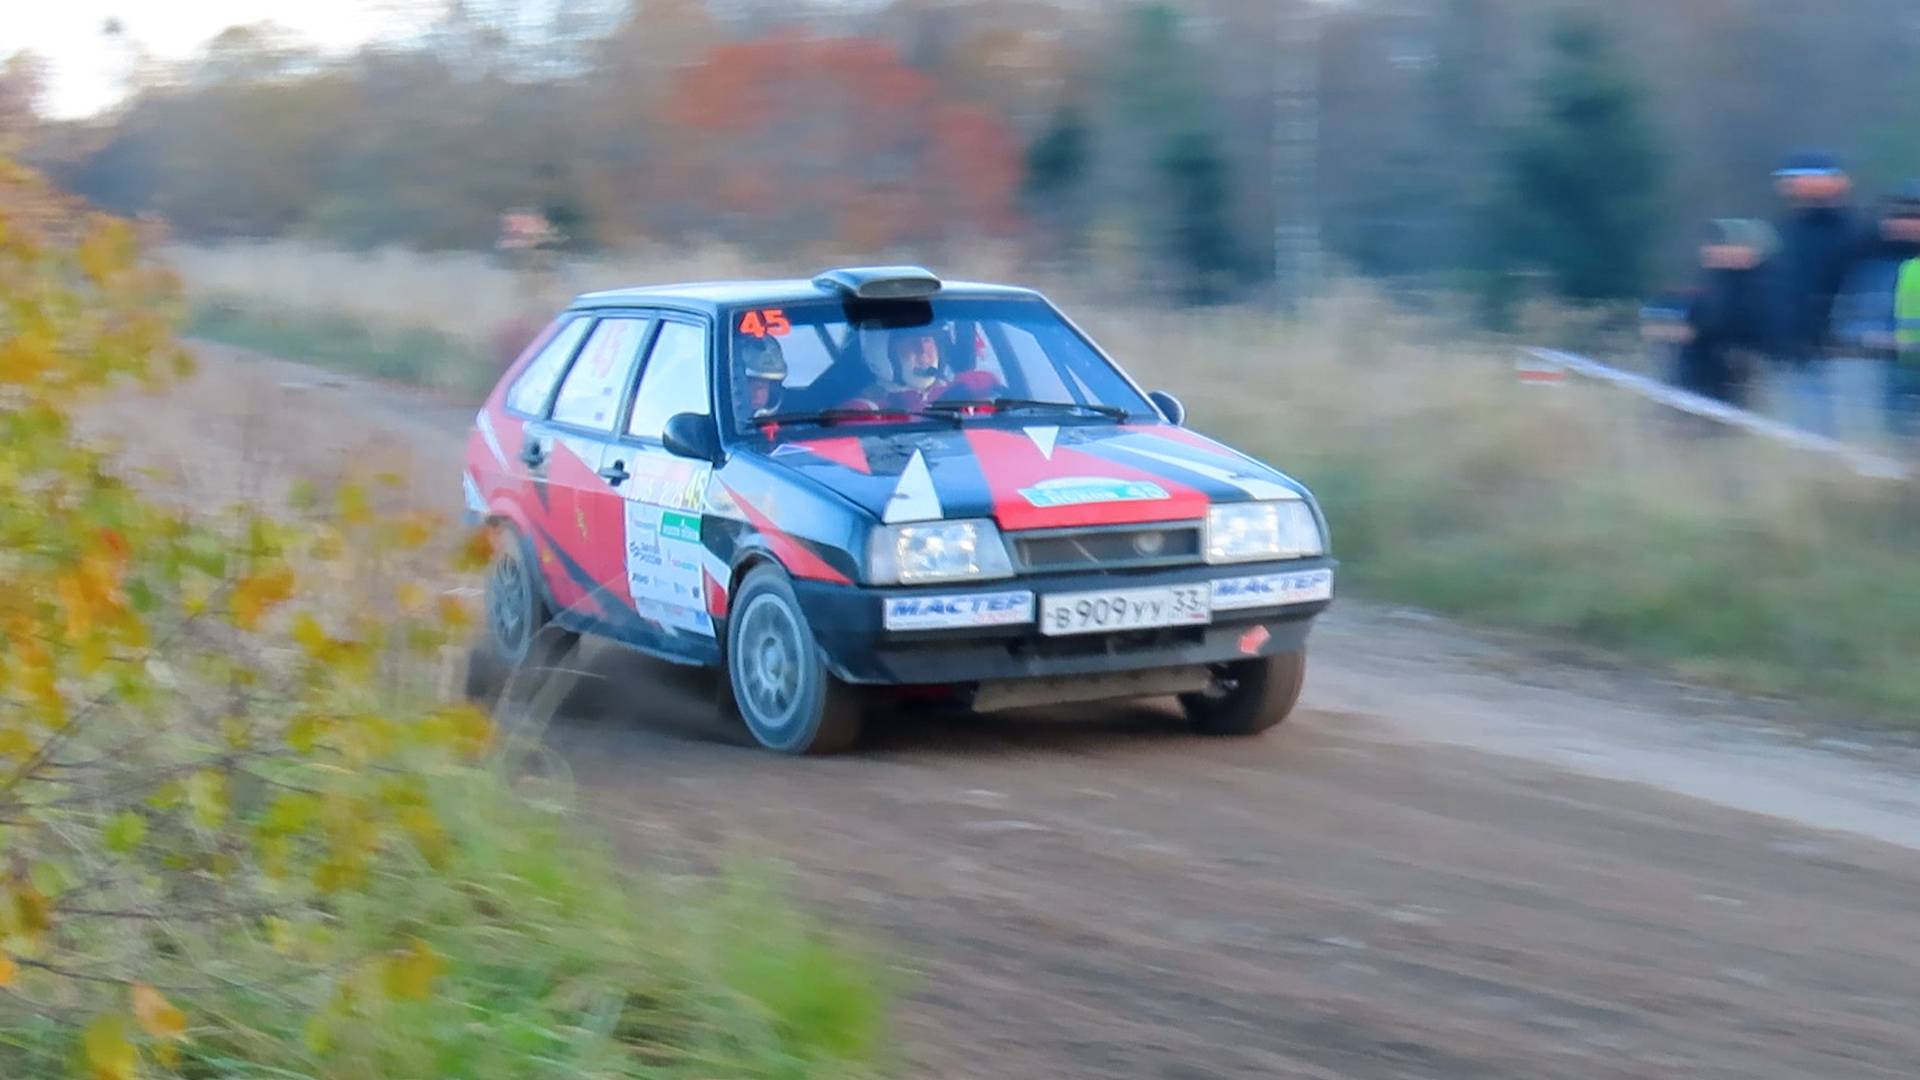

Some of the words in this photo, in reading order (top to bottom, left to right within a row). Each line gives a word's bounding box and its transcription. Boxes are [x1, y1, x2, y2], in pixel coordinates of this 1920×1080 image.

[738, 308, 792, 339] 45
[1215, 573, 1328, 595] МАСТЕР
[893, 594, 1029, 616] МАСТЕР
[1173, 589, 1199, 612] 33
